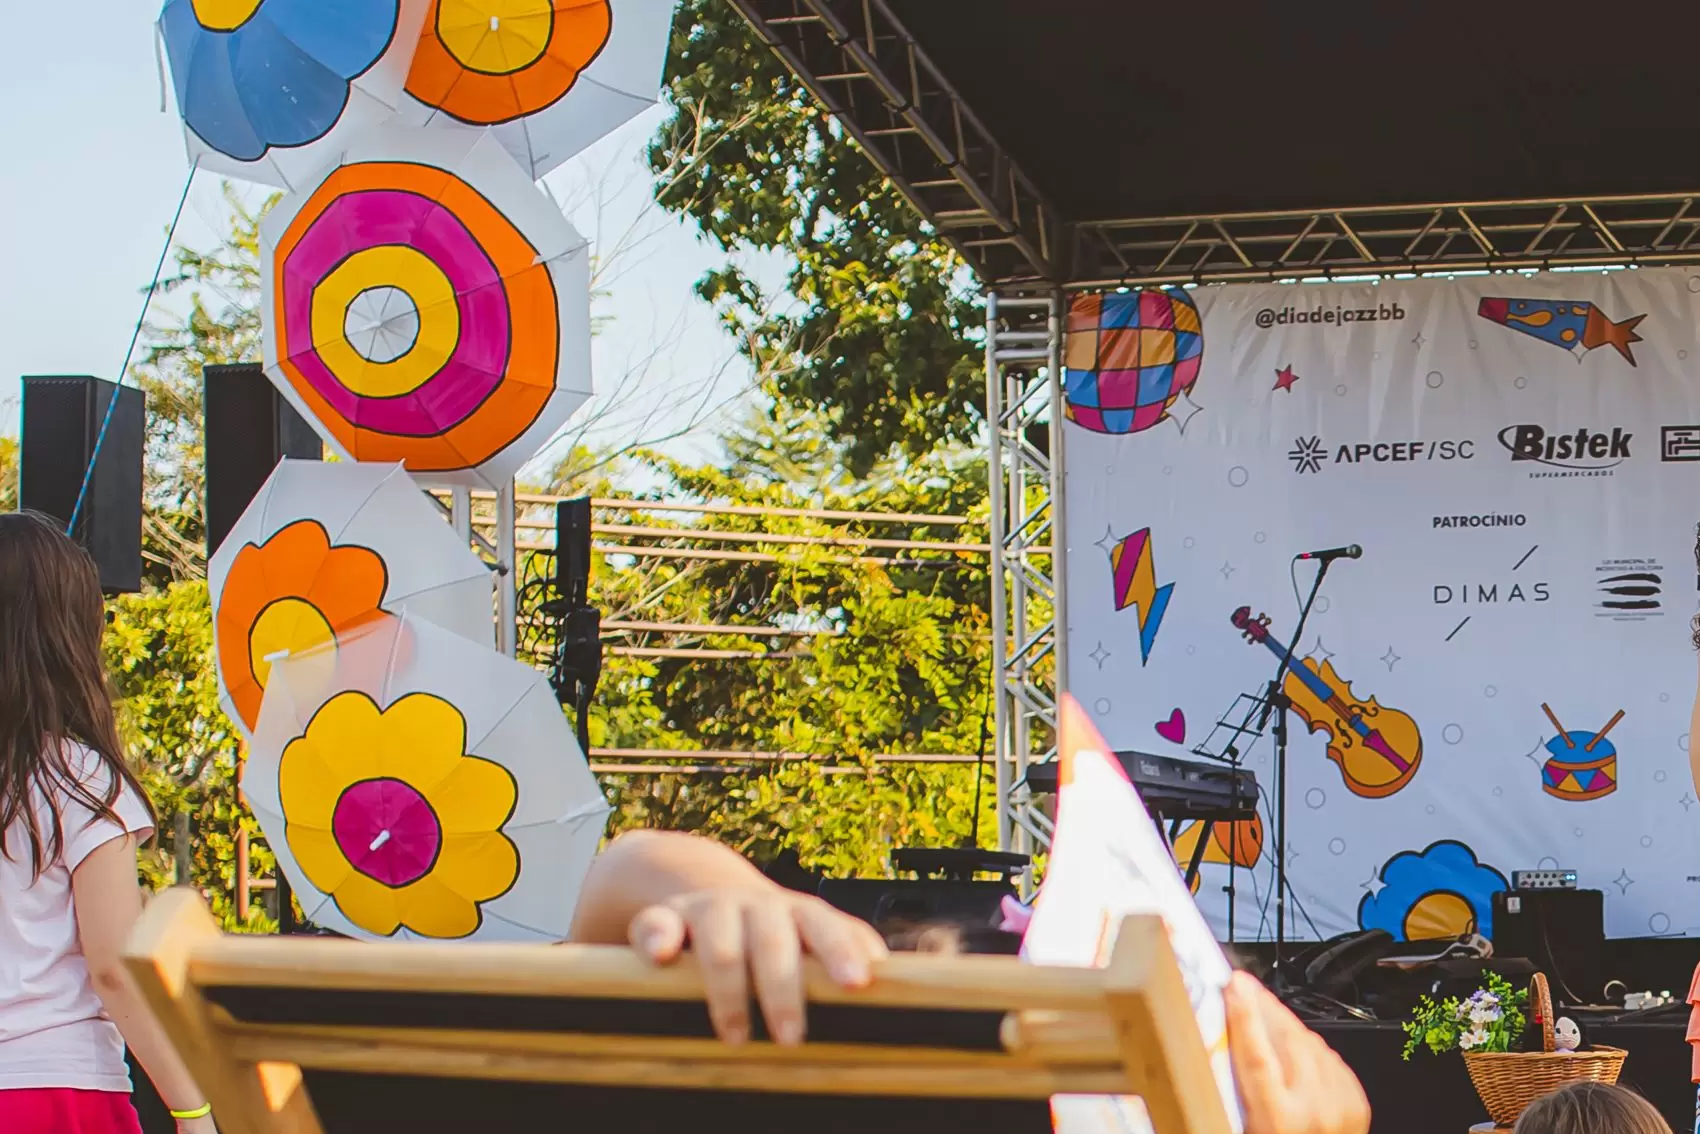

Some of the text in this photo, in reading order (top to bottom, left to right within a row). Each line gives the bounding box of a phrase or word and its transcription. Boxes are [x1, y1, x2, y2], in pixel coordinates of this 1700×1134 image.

[1255, 302, 1406, 329] @diadejazzbb
[1511, 424, 1633, 461] Bistek
[1432, 512, 1527, 529] PATROCÍNIO
[1433, 582, 1550, 604] DIMAS
